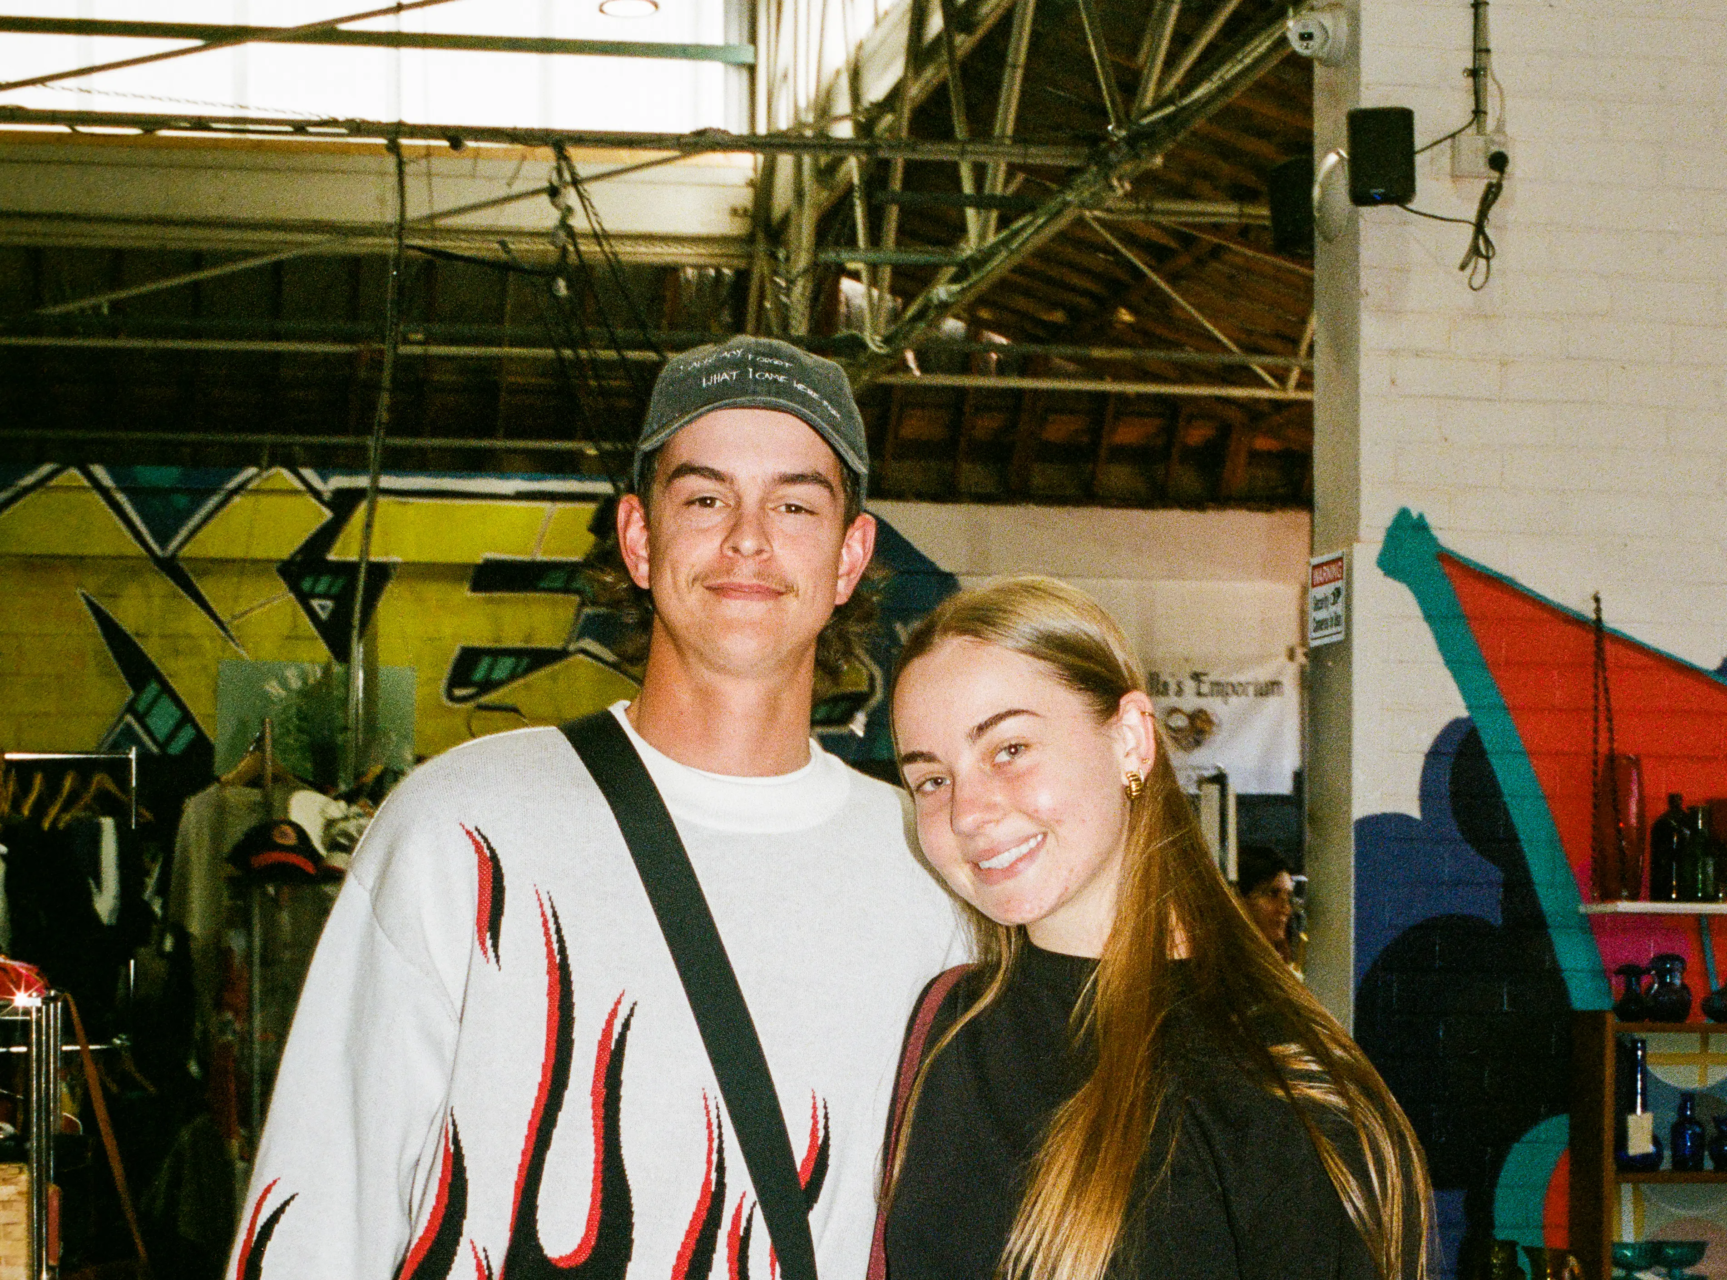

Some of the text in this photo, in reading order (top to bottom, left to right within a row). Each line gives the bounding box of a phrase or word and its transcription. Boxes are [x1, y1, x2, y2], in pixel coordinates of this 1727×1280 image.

[702, 370, 740, 389] WHAT
[748, 368, 753, 379] I
[755, 371, 789, 383] CAME
[1313, 561, 1342, 586] WARNING
[1190, 671, 1285, 706] Emporium
